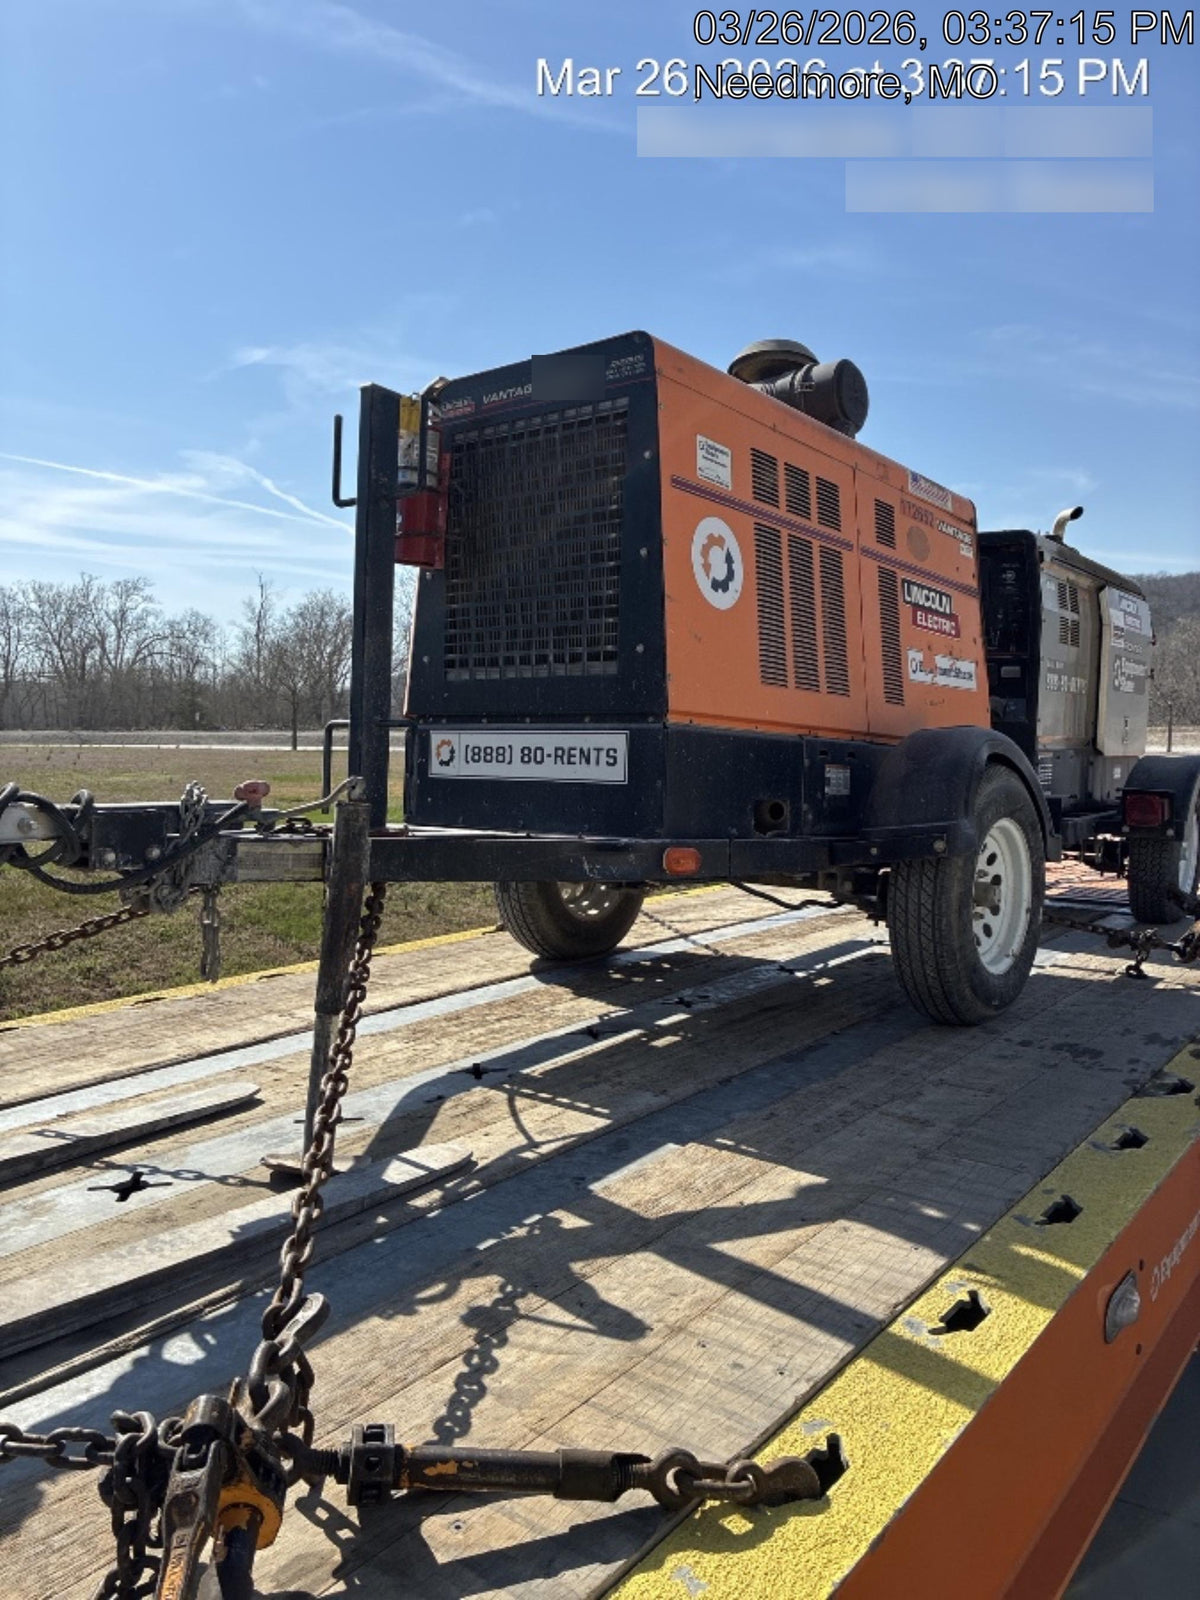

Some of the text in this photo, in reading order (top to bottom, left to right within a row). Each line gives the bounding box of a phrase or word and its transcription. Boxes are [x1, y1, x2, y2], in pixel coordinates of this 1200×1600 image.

[482, 384, 532, 404] VANTAG
[904, 582, 951, 615] LINCOLN
[917, 610, 956, 636] ELECTRIC
[520, 746, 618, 767] 80-RENTS
